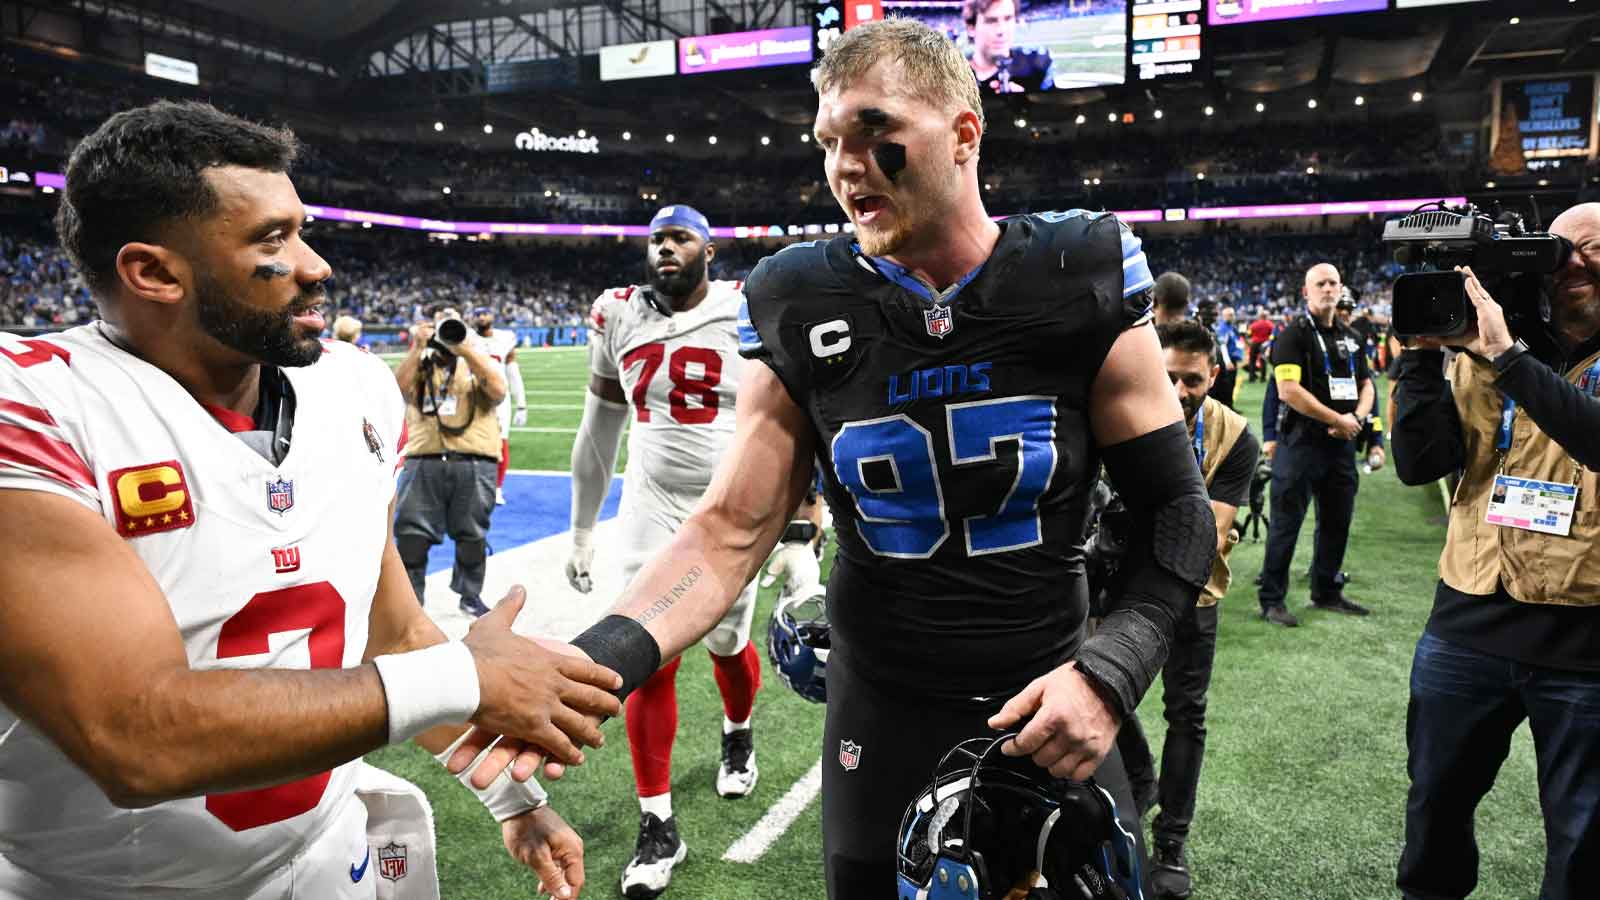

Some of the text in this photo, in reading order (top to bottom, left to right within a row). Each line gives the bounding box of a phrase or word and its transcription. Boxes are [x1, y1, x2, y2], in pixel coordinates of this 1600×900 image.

[534, 132, 599, 153] Rocket
[809, 319, 852, 358] C
[623, 342, 723, 425] 78
[888, 362, 993, 405] LIONS
[117, 465, 186, 518] C
[831, 395, 1058, 558] 97
